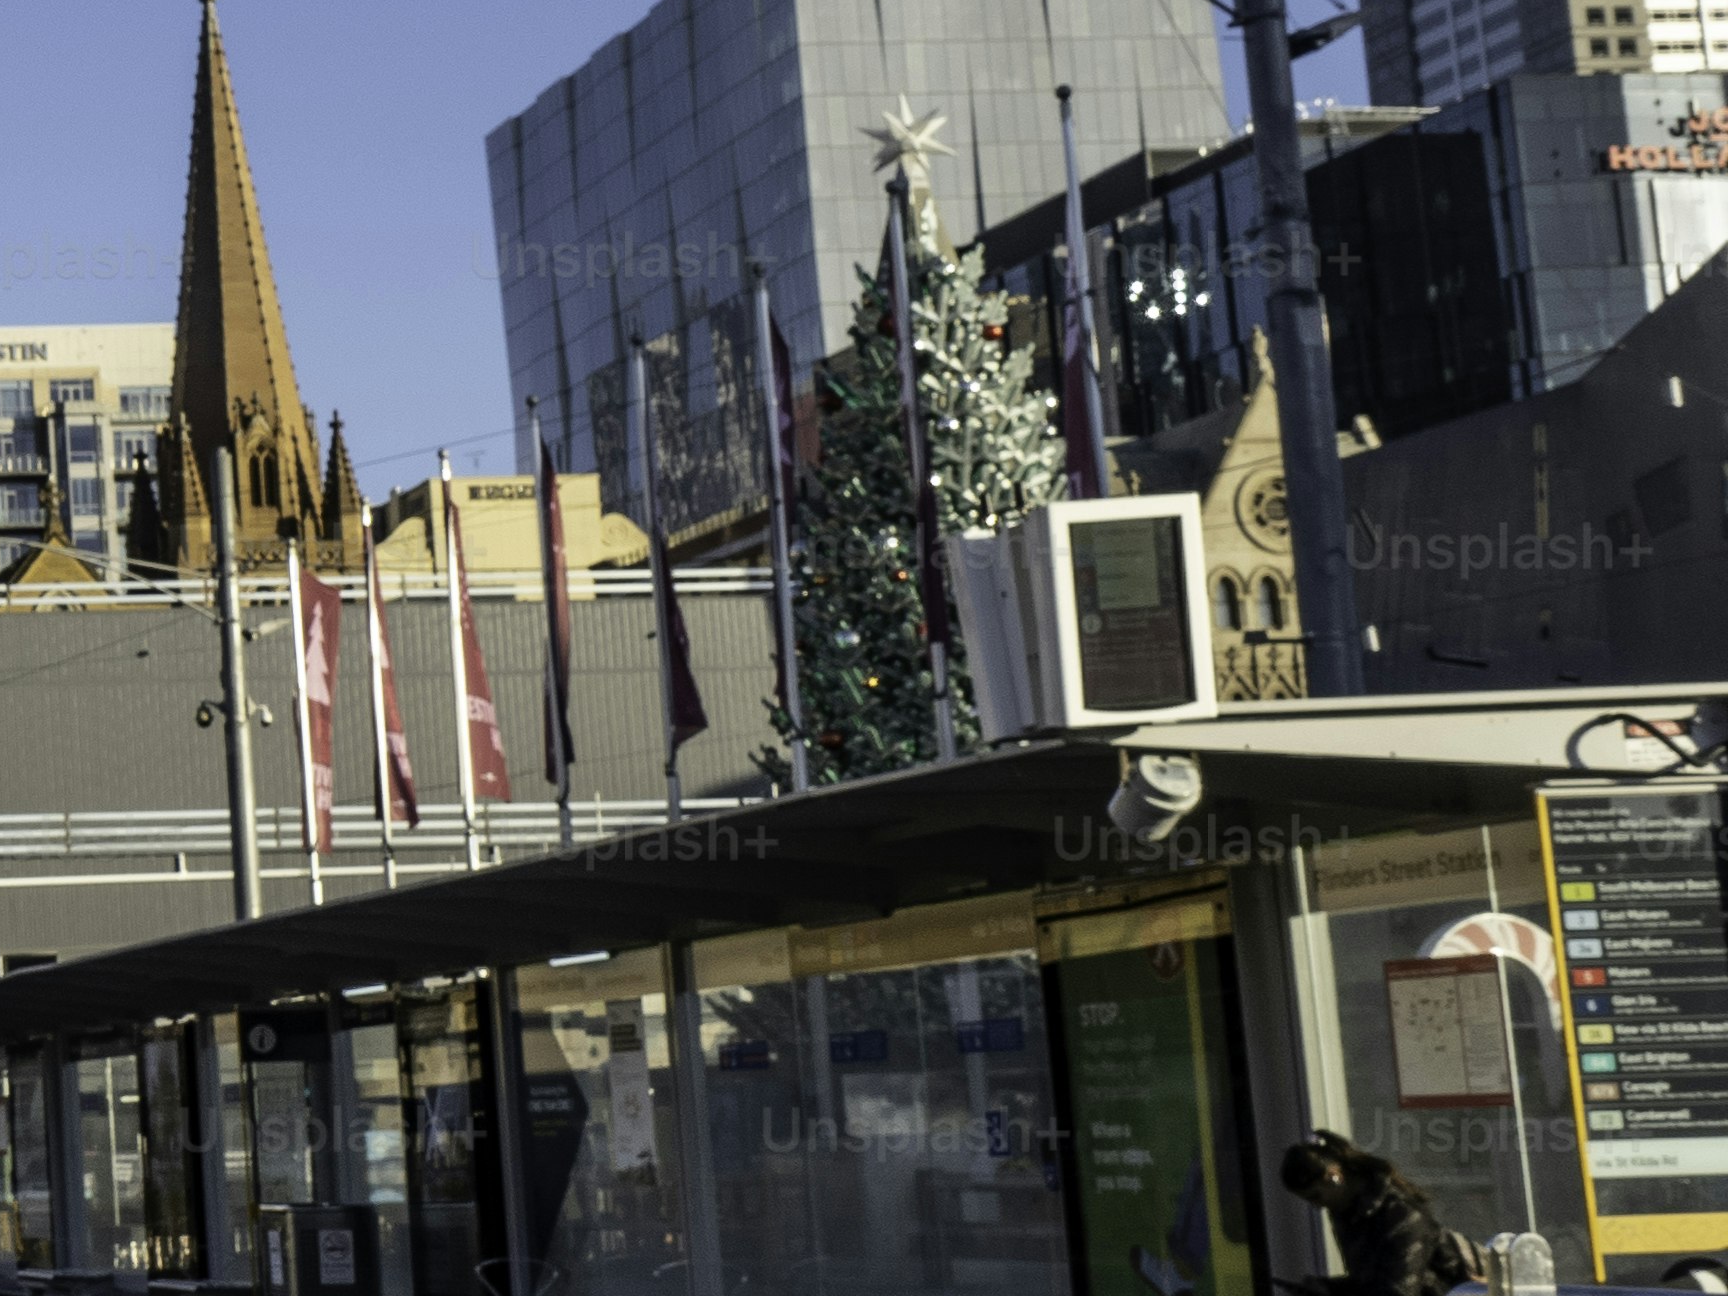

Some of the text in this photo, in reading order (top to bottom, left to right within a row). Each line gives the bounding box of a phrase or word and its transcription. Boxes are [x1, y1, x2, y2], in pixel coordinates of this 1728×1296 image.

[1379, 858, 1432, 883] Street
[1436, 848, 1502, 875] Station
[1598, 882, 1629, 893] South
[1630, 880, 1685, 892] Melbourne
[1600, 910, 1627, 921] East
[1627, 910, 1670, 921] Malvern
[1604, 938, 1630, 950] East
[1630, 937, 1673, 950] Malvern
[1607, 967, 1651, 978] Malvern
[1618, 1052, 1644, 1064] East
[1645, 1052, 1691, 1066] Brighton
[1622, 1081, 1671, 1096] Carnegie
[1625, 1108, 1692, 1121] Camberwell
[1595, 1155, 1679, 1168] via St Kilda Rd
